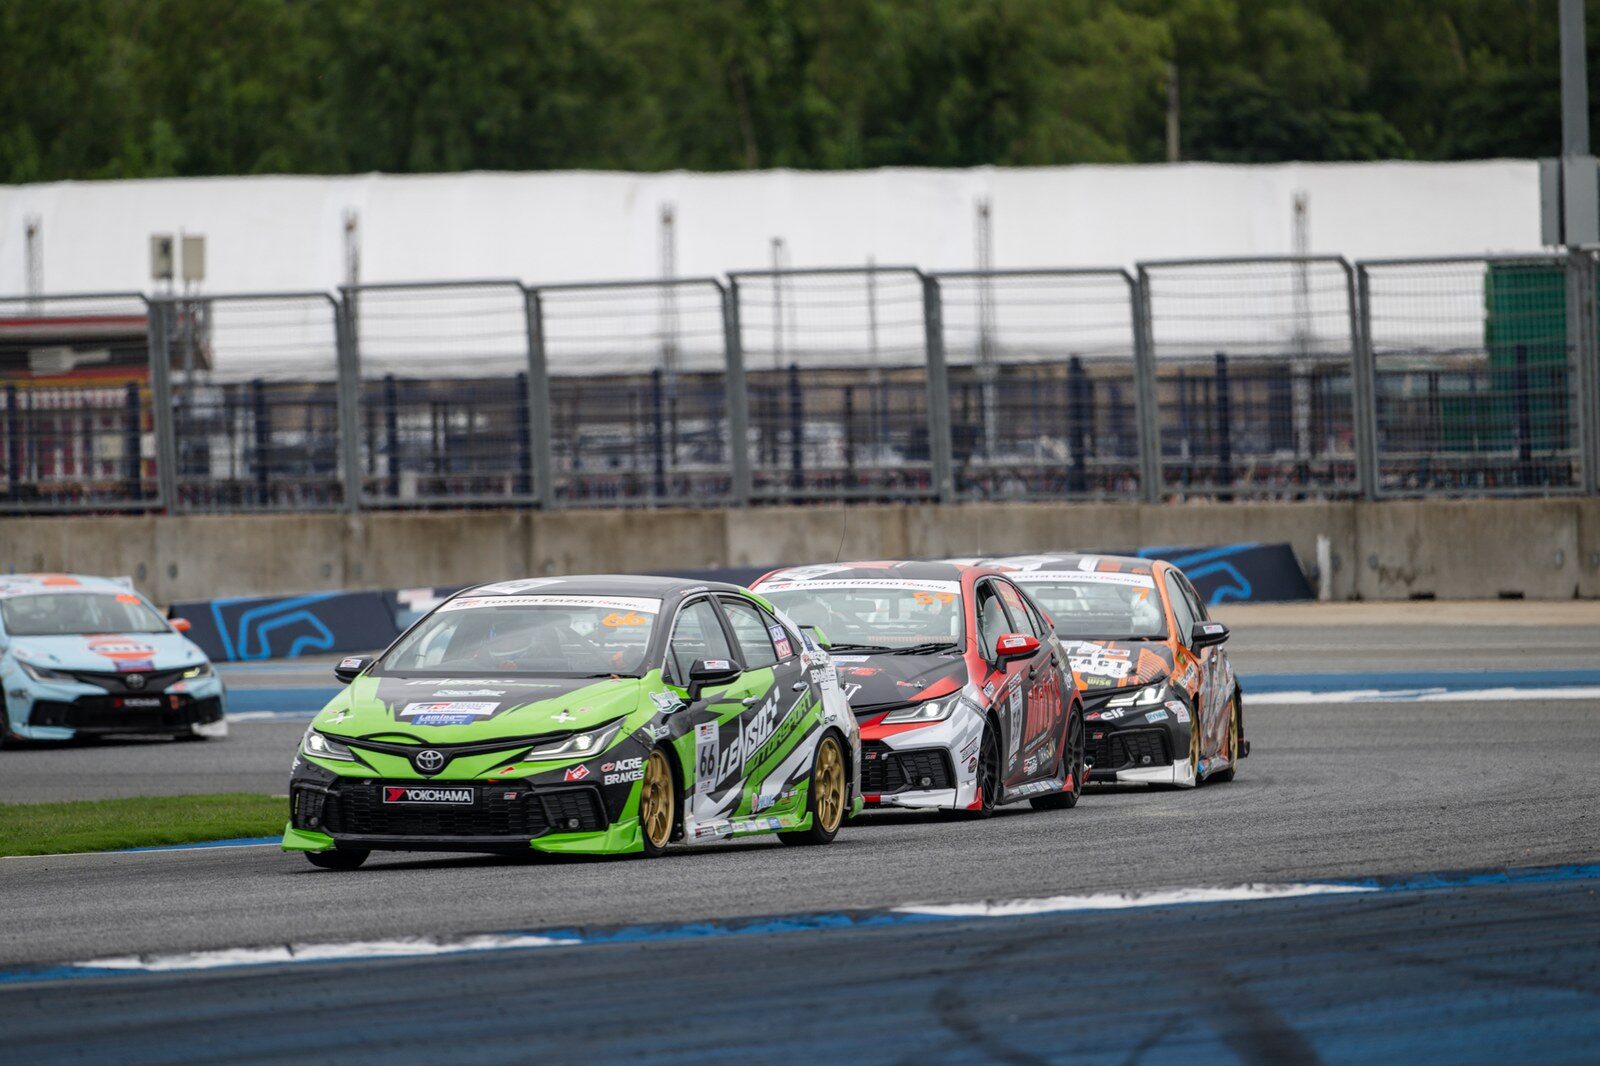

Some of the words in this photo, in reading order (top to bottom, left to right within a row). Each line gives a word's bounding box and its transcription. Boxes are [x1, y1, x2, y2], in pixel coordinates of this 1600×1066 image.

[902, 581, 947, 590] Racing
[912, 592, 955, 606] 59
[1132, 587, 1149, 602] 7
[602, 611, 646, 628] 66
[1101, 707, 1125, 721] elf
[615, 757, 643, 772] ACRE
[699, 744, 715, 778] 66
[604, 770, 644, 786] BRAKES
[406, 789, 471, 802] YOKOHAMA
